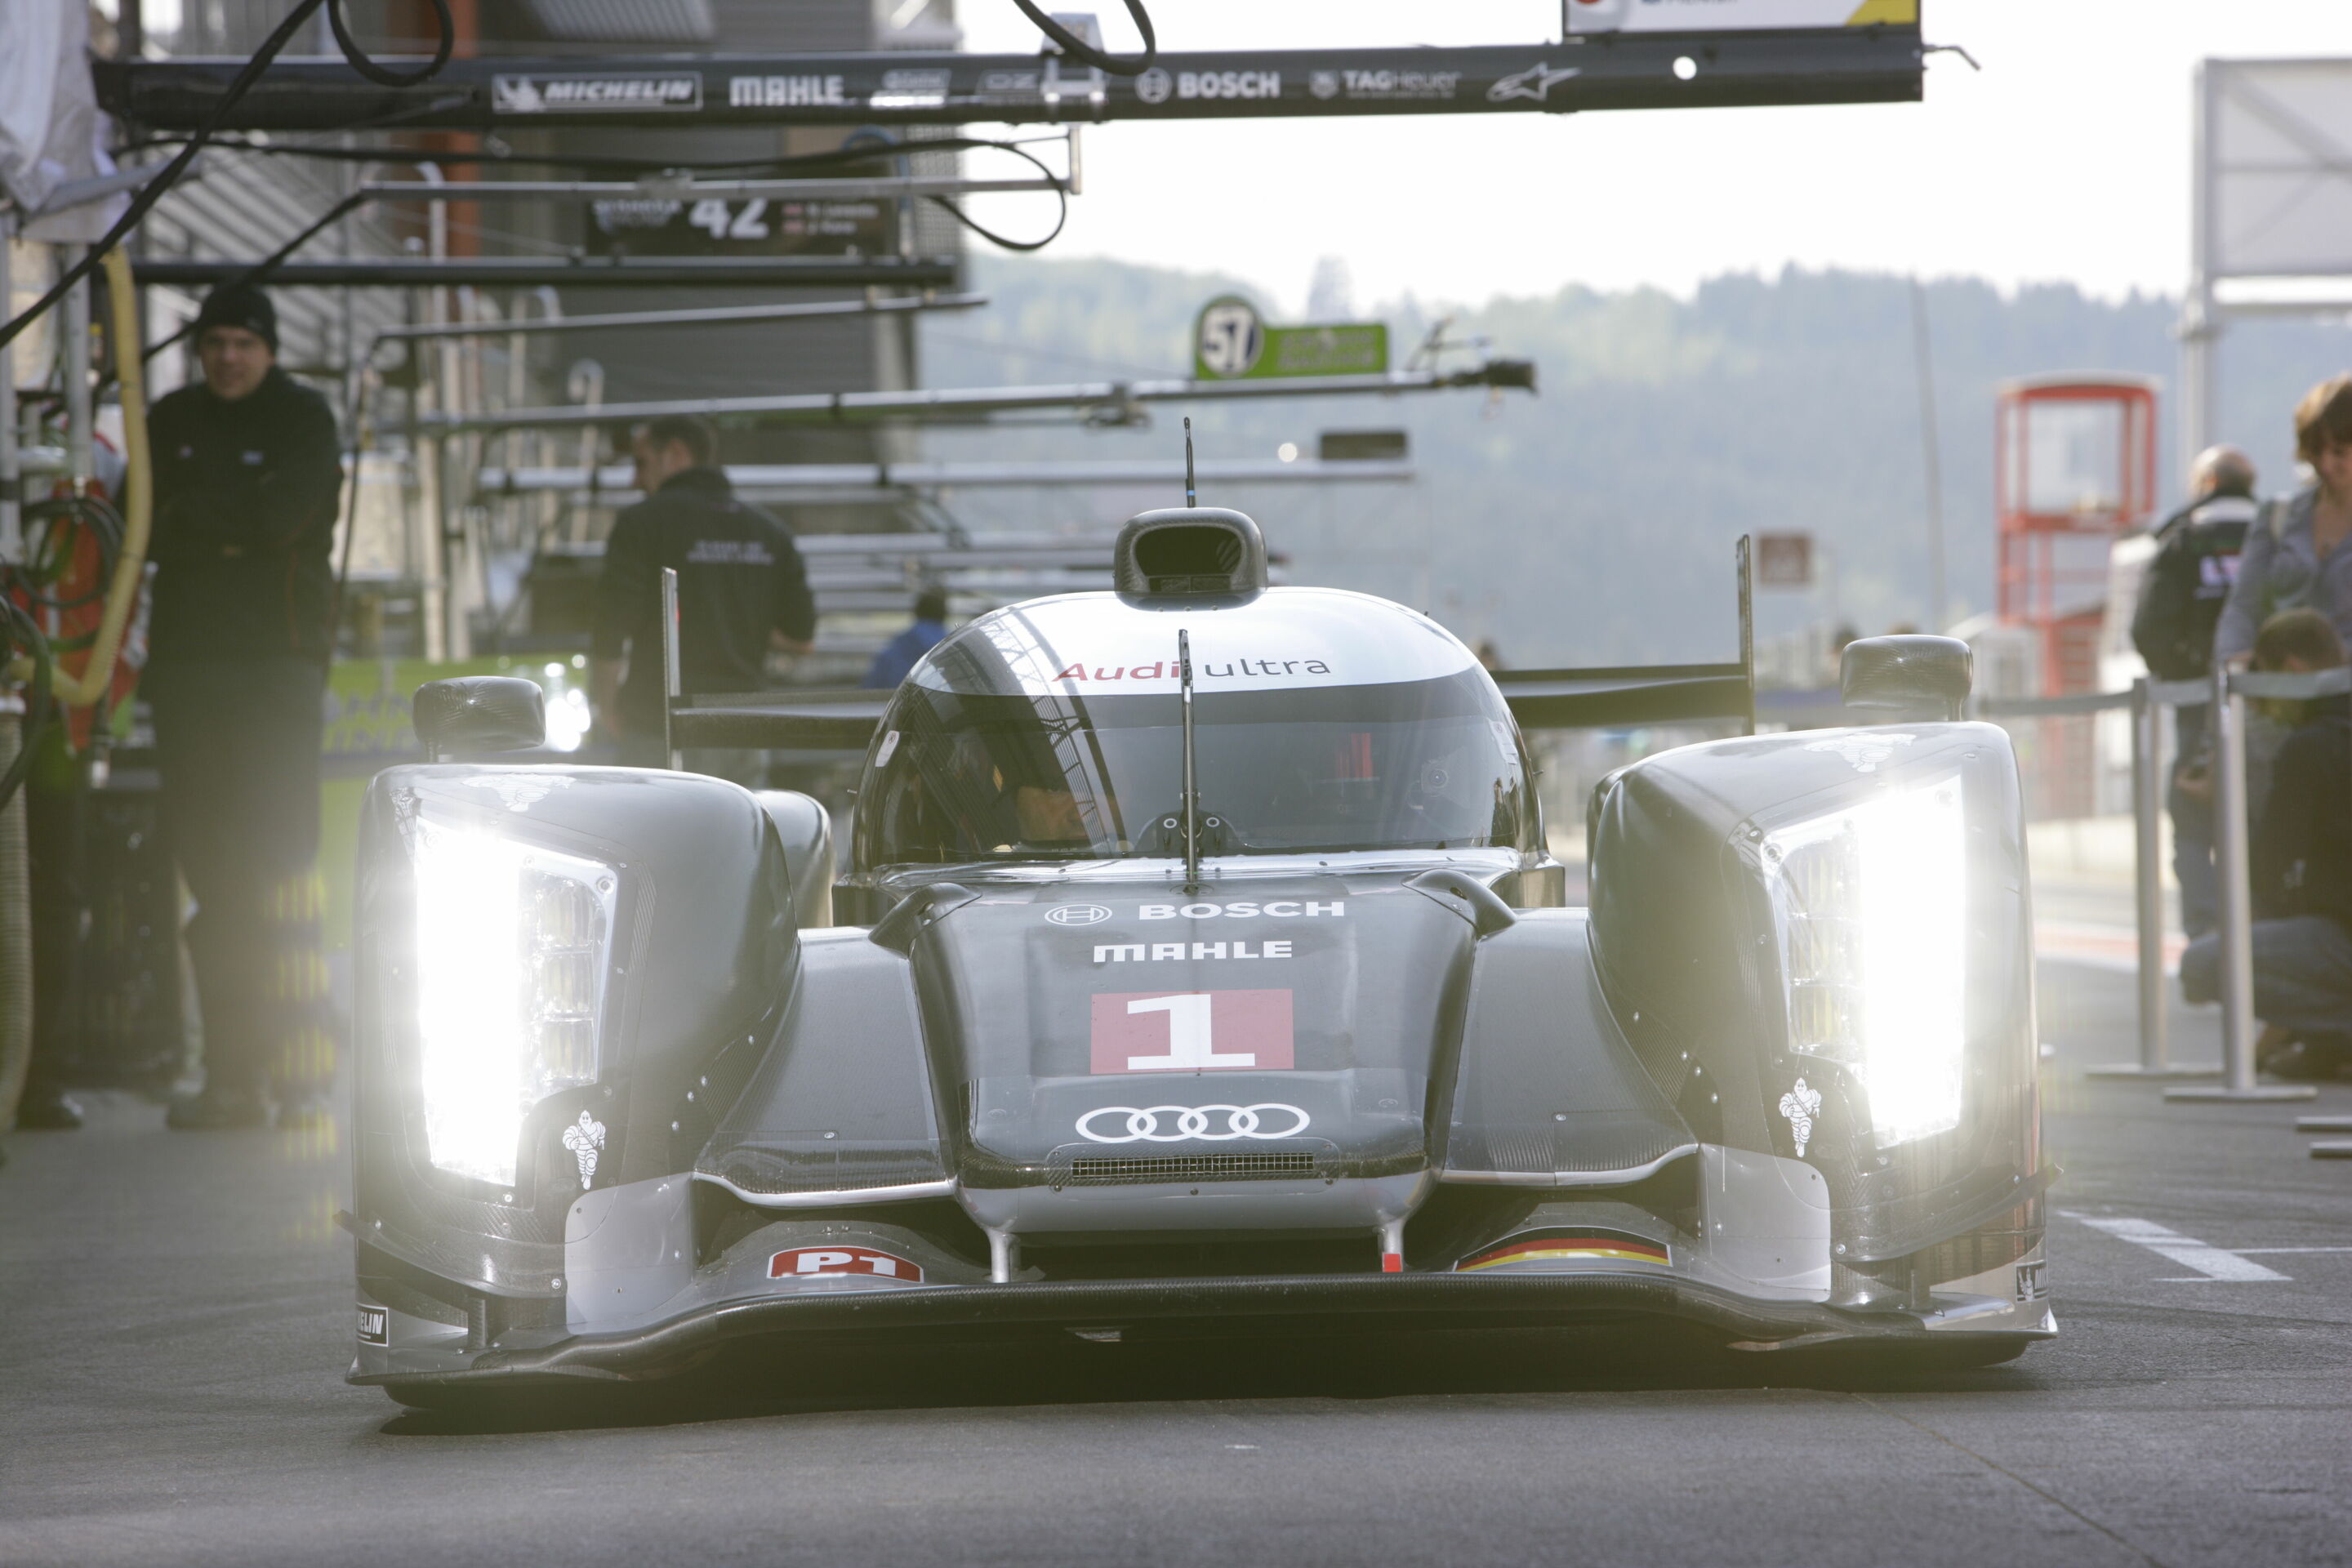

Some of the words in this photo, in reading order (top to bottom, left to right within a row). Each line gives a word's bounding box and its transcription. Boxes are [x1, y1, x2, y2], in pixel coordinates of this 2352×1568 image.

[545, 79, 694, 100] MICHELIN
[730, 75, 844, 107] MAHLE
[1178, 71, 1281, 99] BOSCH
[688, 198, 769, 239] 42
[1202, 304, 1256, 371] 57
[1052, 661, 1181, 682] Audi
[1205, 658, 1332, 677] ultra
[1139, 902, 1344, 920] BOSCH
[1094, 941, 1292, 963] MAHLE
[1127, 993, 1255, 1071] 1
[796, 1252, 897, 1276] P1
[359, 1311, 384, 1334] ELIN
